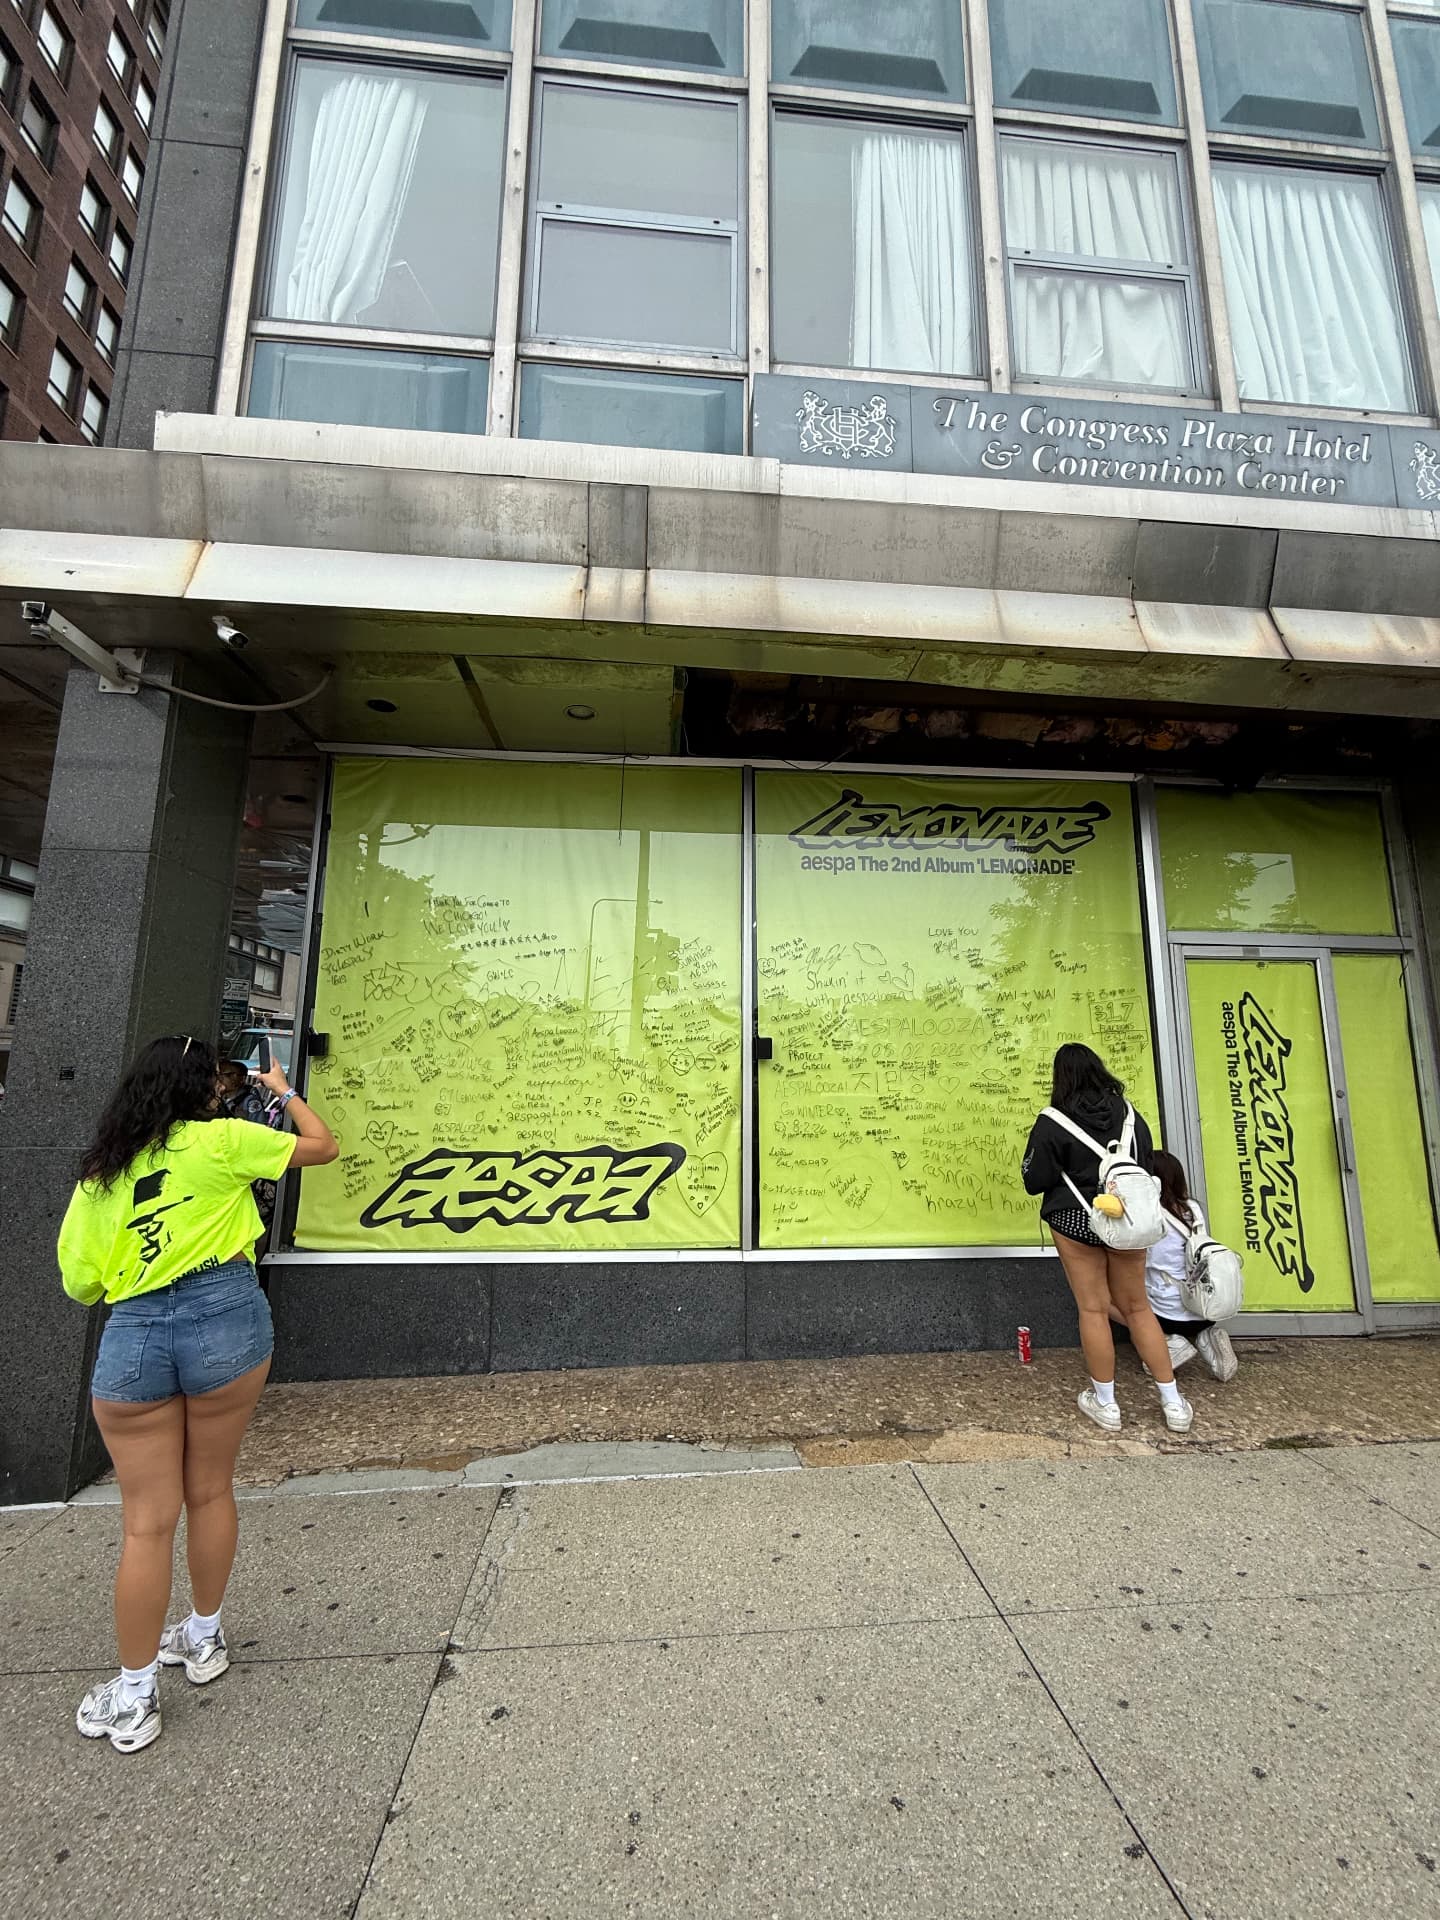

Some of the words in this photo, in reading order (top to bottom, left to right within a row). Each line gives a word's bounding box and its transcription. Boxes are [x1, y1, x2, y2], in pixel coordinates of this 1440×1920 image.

[932, 396, 1008, 432] The
[1020, 405, 1169, 450] Congress
[1182, 418, 1275, 457] Plaza
[1286, 427, 1372, 463] Hotel
[981, 440, 1022, 470] &
[1032, 444, 1225, 488] Convention
[1236, 461, 1345, 497] Center
[788, 789, 1112, 854] LEMONADE
[800, 856, 856, 876] aespa
[858, 856, 889, 872] The
[891, 856, 922, 872] 2nd
[923, 857, 976, 874] Album
[977, 859, 1076, 875] 'LEMONADE'
[928, 928, 955, 937] LOVE
[958, 927, 979, 936] YOU
[1221, 1001, 1237, 1048] aespa
[1226, 1050, 1241, 1079] The
[1229, 1080, 1243, 1108] 2nd
[1231, 1109, 1247, 1156] Album
[1238, 1158, 1261, 1254] 'LEMONADE'
